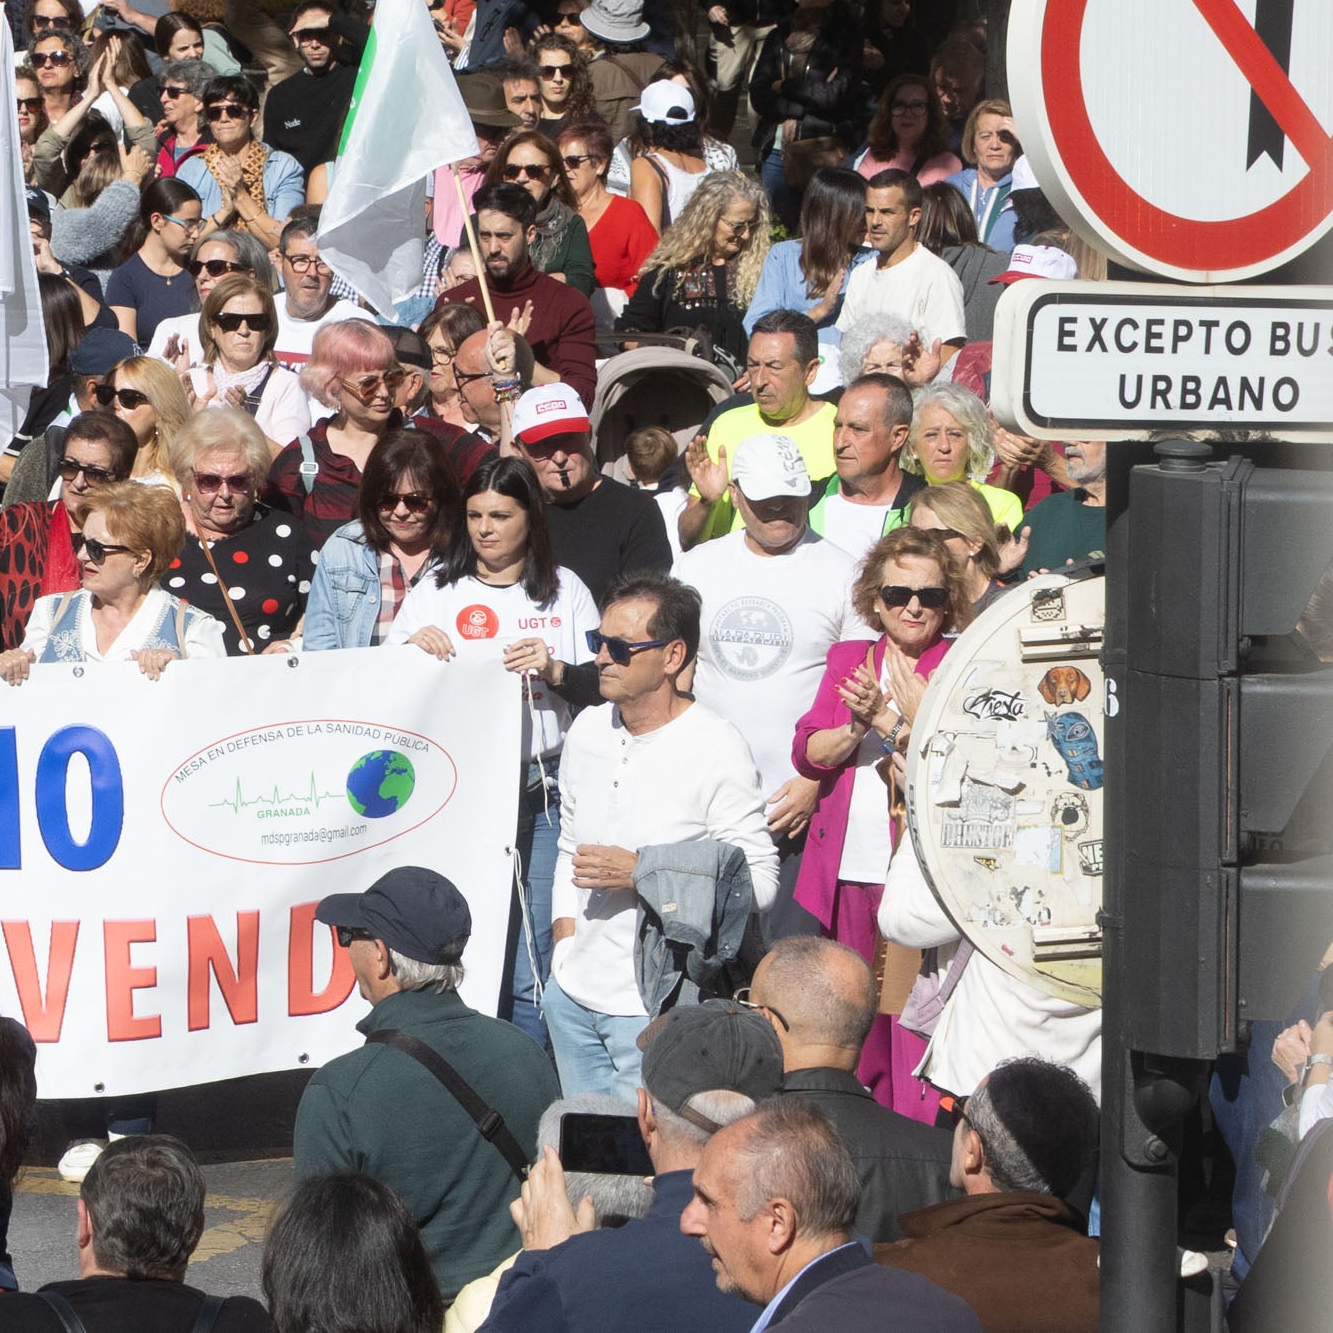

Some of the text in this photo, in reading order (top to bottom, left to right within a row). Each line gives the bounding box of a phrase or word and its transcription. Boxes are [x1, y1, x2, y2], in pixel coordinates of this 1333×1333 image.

[1057, 316, 1333, 357] EXCEPTO BU
[1118, 373, 1300, 413] URBANO
[462, 623, 490, 639] UGT
[517, 617, 548, 630] UGT
[175, 722, 431, 784] MESA EN DEFENSA DE LA SANIDAD PÚBLICA
[256, 807, 311, 819] GRANADA
[260, 823, 368, 847] mdspgranada@gmail.com
